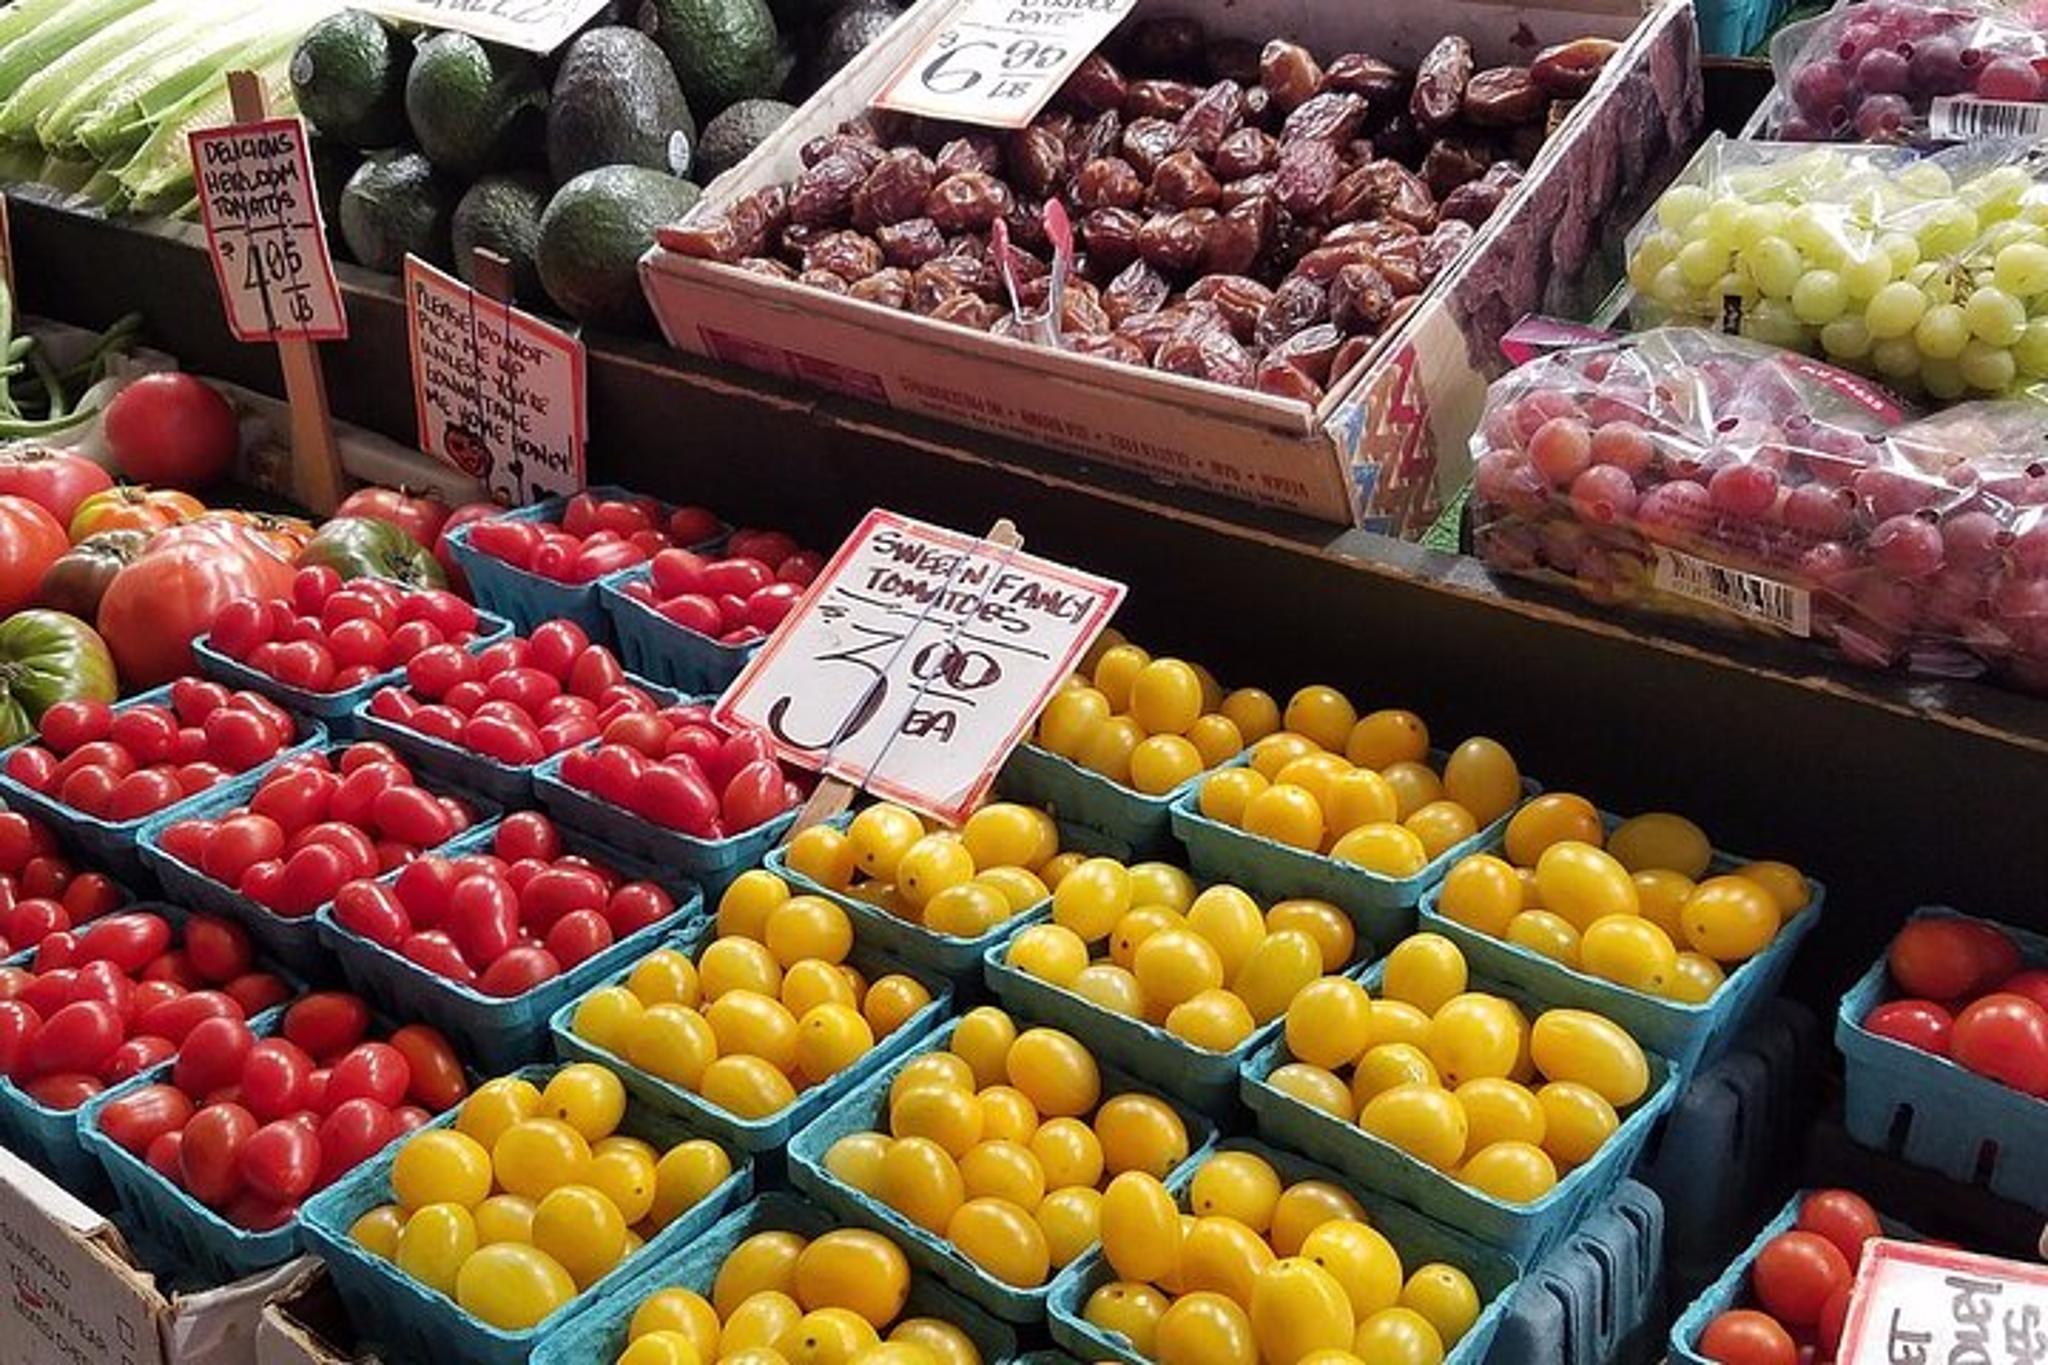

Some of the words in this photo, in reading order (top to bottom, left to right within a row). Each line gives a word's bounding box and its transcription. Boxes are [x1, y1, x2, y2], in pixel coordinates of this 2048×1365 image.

[203, 133, 295, 165] DELICIOUS
[204, 159, 299, 194] HEIRLOOM
[416, 281, 471, 333] PLEASE
[477, 320, 501, 346] DO
[503, 337, 553, 367] NOT
[418, 310, 459, 349] PICK
[462, 337, 490, 366] ME
[424, 385, 450, 417] ME
[457, 404, 505, 446] HOME
[866, 567, 1031, 634] TOMATOES
[991, 573, 1096, 624] FANCY
[900, 708, 958, 744] EA
